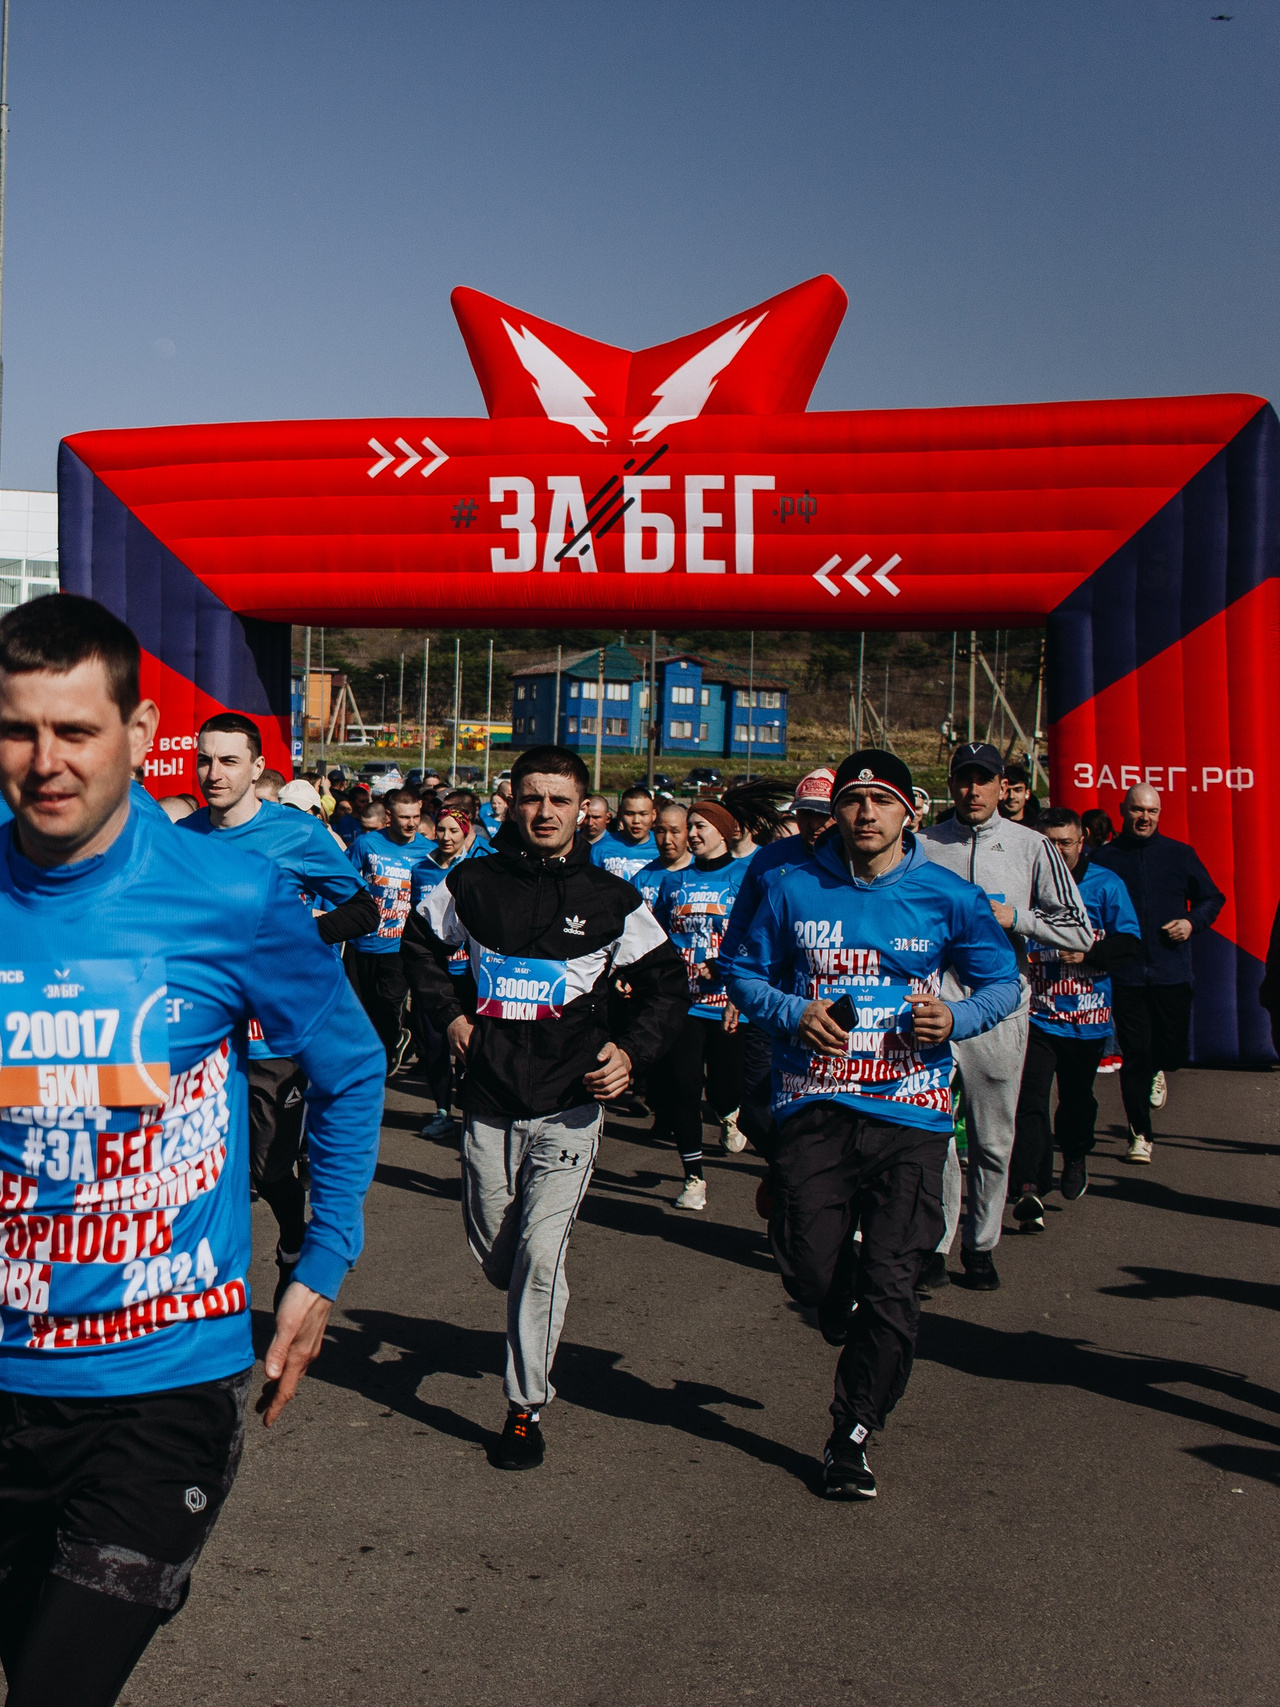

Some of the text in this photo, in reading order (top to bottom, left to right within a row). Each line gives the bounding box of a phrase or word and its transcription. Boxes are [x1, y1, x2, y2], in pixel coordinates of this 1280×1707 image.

[794, 920, 844, 949] 2024
[495, 976, 551, 1002] 30002
[1076, 992, 1105, 1011] 2024
[5, 1008, 120, 1060] 20017
[22, 1124, 165, 1182] #ЗАБЕГ
